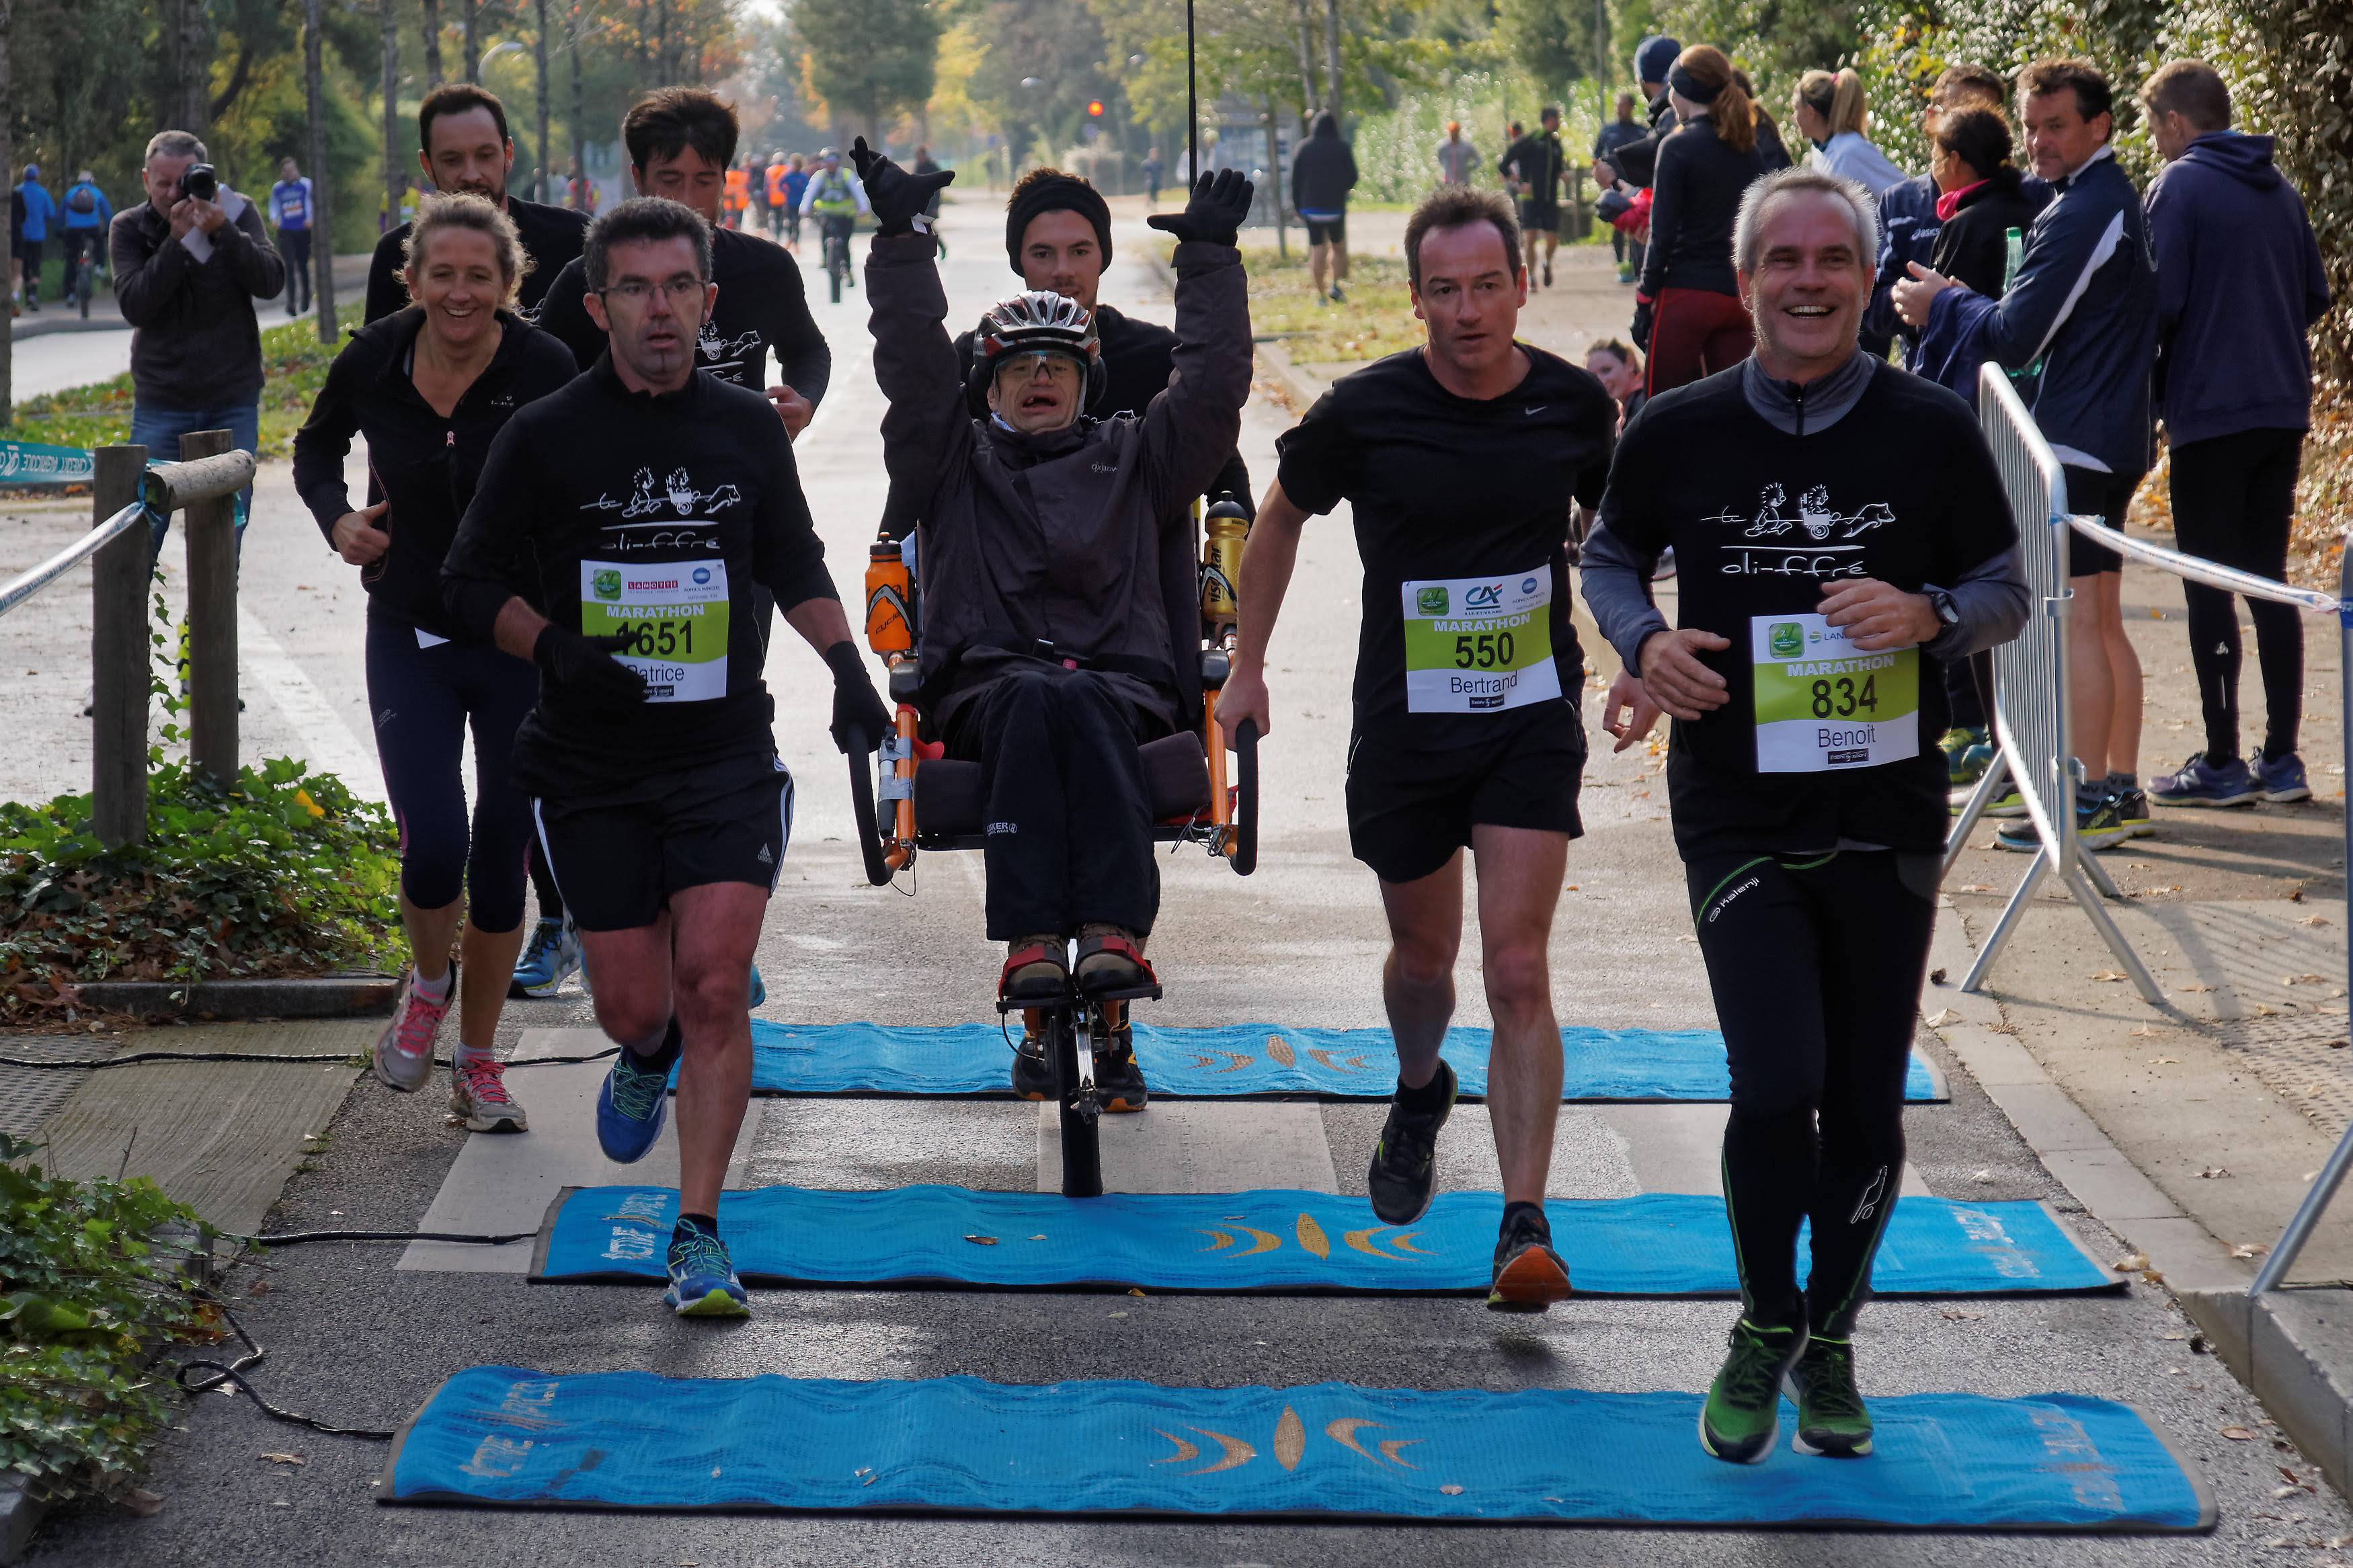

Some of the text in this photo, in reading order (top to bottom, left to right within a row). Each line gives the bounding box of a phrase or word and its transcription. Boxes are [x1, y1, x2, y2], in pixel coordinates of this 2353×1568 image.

[628, 581, 678, 589] LAMOTTE
[606, 604, 705, 618] MARATHON
[1434, 612, 1531, 632] MARATHON
[616, 620, 692, 656] 1651
[1455, 632, 1515, 669] 550
[1787, 654, 1895, 677] MARATHON
[1451, 669, 1517, 694] Bertrand
[1812, 674, 1878, 718] 834
[1818, 724, 1876, 748] Benoit
